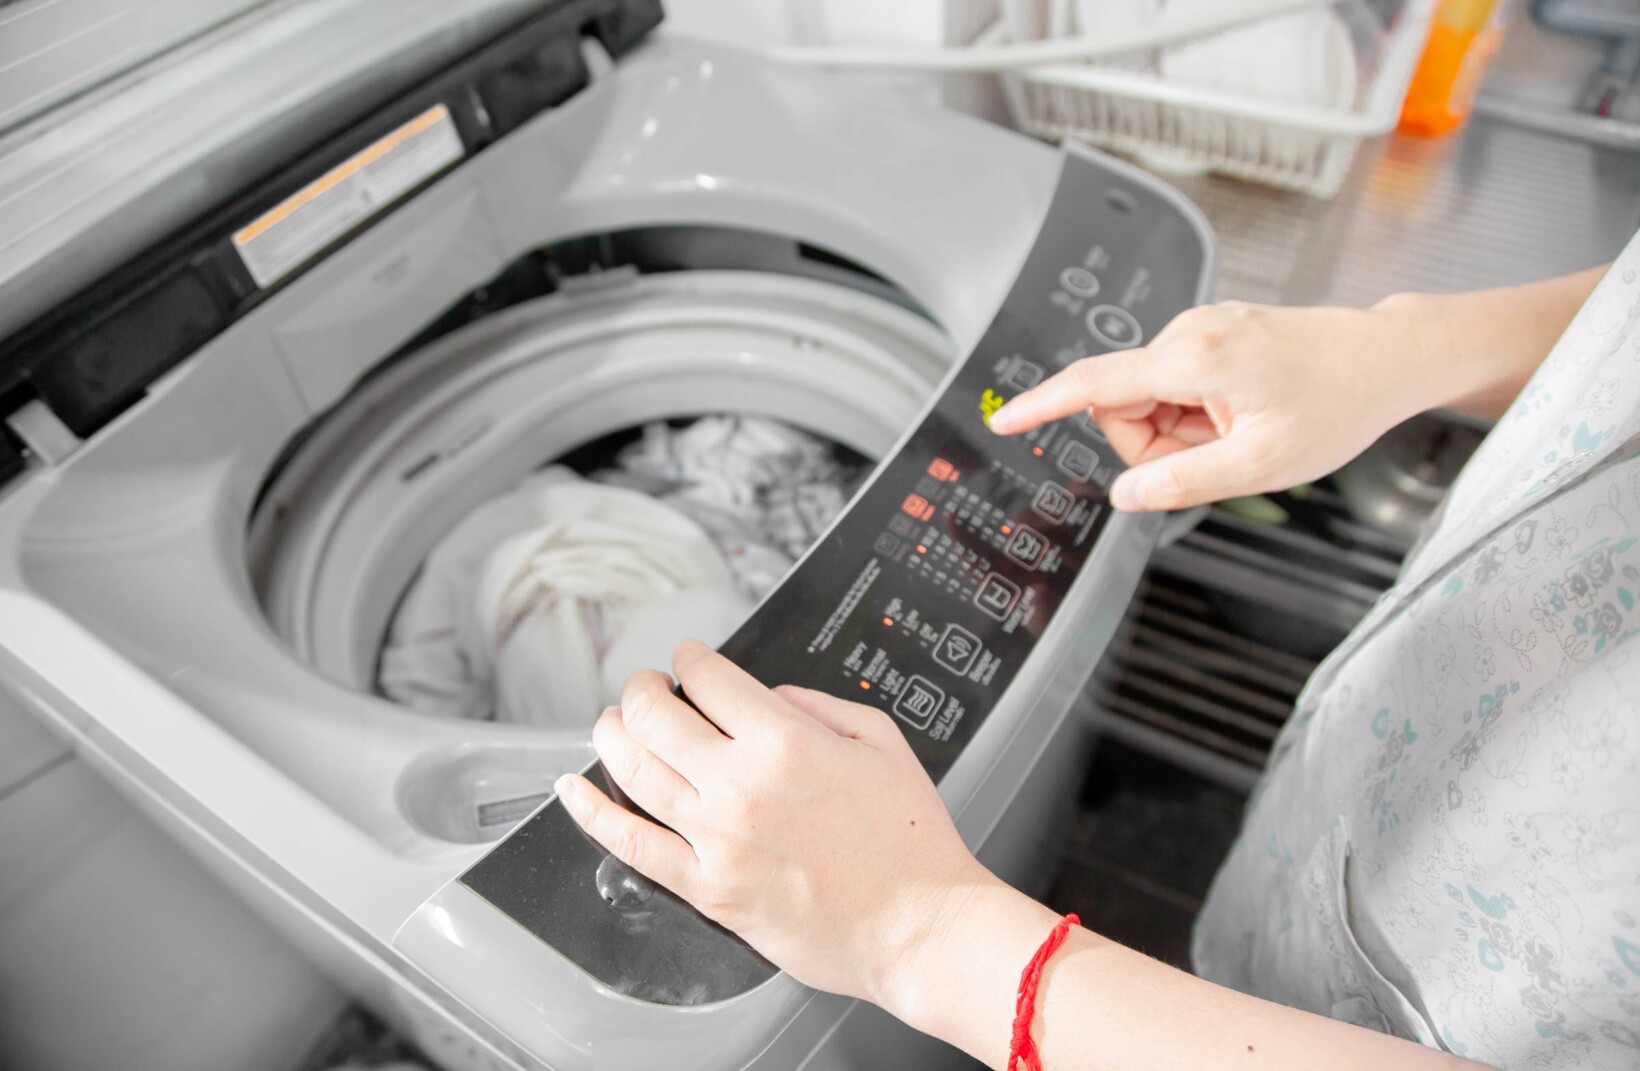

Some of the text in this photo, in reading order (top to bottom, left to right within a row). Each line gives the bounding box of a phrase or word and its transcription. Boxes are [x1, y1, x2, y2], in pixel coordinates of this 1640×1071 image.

[842, 640, 868, 669] Heavy
[860, 647, 887, 680] Normal
[967, 648, 994, 682] Beeper
[878, 667, 900, 691] Light
[927, 719, 946, 741] Soil
[938, 695, 960, 723] Level
